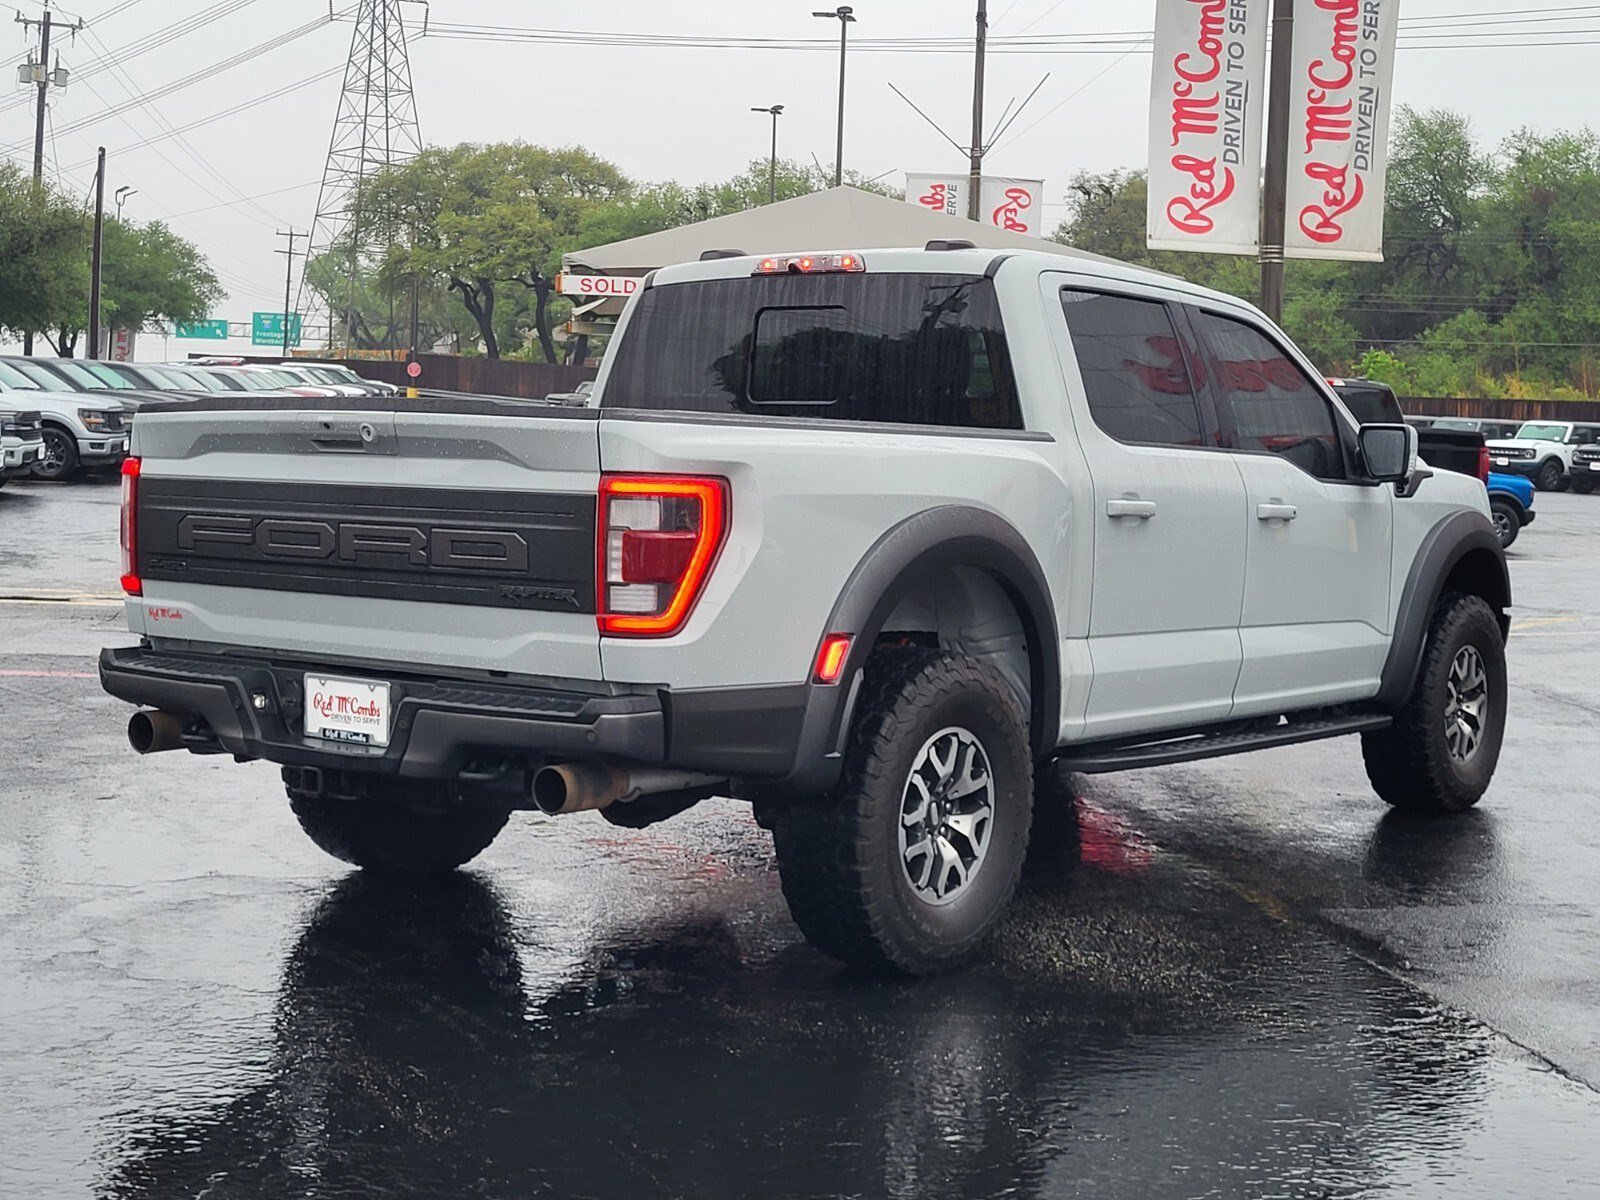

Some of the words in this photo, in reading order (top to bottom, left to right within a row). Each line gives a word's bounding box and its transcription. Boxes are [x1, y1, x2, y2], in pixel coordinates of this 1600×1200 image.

[1226, 41, 1245, 72] TO
[1359, 48, 1377, 78] TO
[1222, 80, 1243, 165] DRIVEN
[1353, 86, 1375, 172] DRIVEN
[993, 188, 1032, 233] Red
[1167, 154, 1235, 234] Red
[1299, 162, 1364, 243] Red
[580, 278, 637, 294] SOLD
[177, 514, 529, 573] FORD
[498, 583, 580, 607] RAPTOR
[313, 692, 334, 718] Red
[335, 695, 381, 718] McCombs
[330, 713, 352, 723] DRIVEN
[353, 715, 361, 723] TO
[362, 716, 381, 726] SERVE
